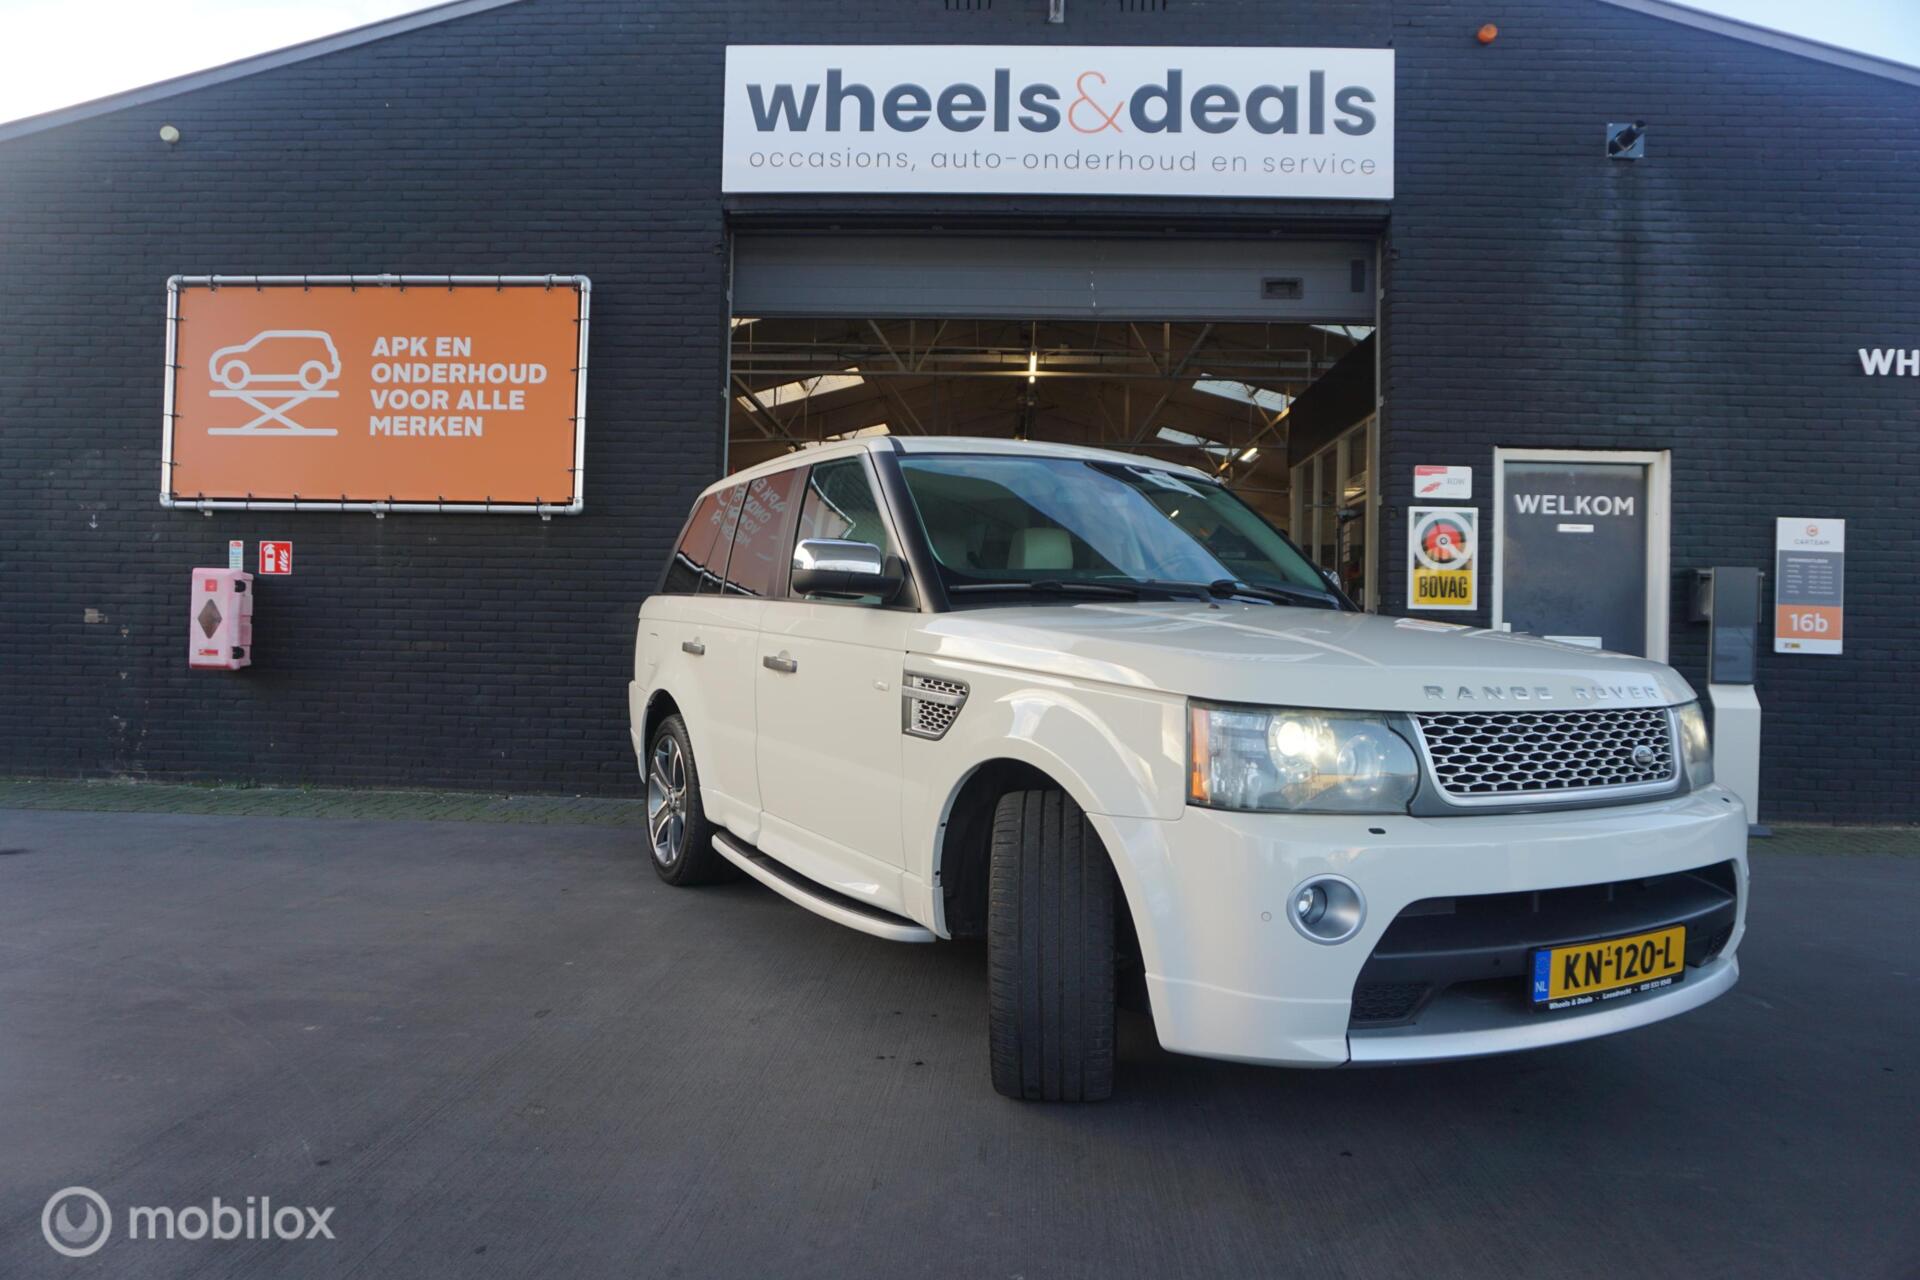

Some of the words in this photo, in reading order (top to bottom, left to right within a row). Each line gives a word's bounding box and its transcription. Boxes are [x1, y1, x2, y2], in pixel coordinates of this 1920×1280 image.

[746, 68, 1376, 137] wheels&deals
[748, 146, 918, 172] occasions,
[930, 149, 1197, 172] auto-onderhoud
[1211, 151, 1248, 172] en
[1262, 153, 1376, 175] service
[371, 336, 428, 357] APK
[435, 337, 472, 358] EN
[370, 362, 548, 384] ONDERHOUD
[1858, 348, 1920, 376] WH
[370, 389, 449, 411] VOOR
[456, 390, 525, 411] ALLE
[369, 415, 484, 437] MERKEN
[1514, 493, 1635, 516] WELKOM
[1419, 575, 1468, 599] BOVAG
[1790, 613, 1829, 633] 16b
[1423, 684, 1553, 700] RANGE
[1571, 685, 1659, 699] ROVER
[1535, 980, 1548, 993] NL
